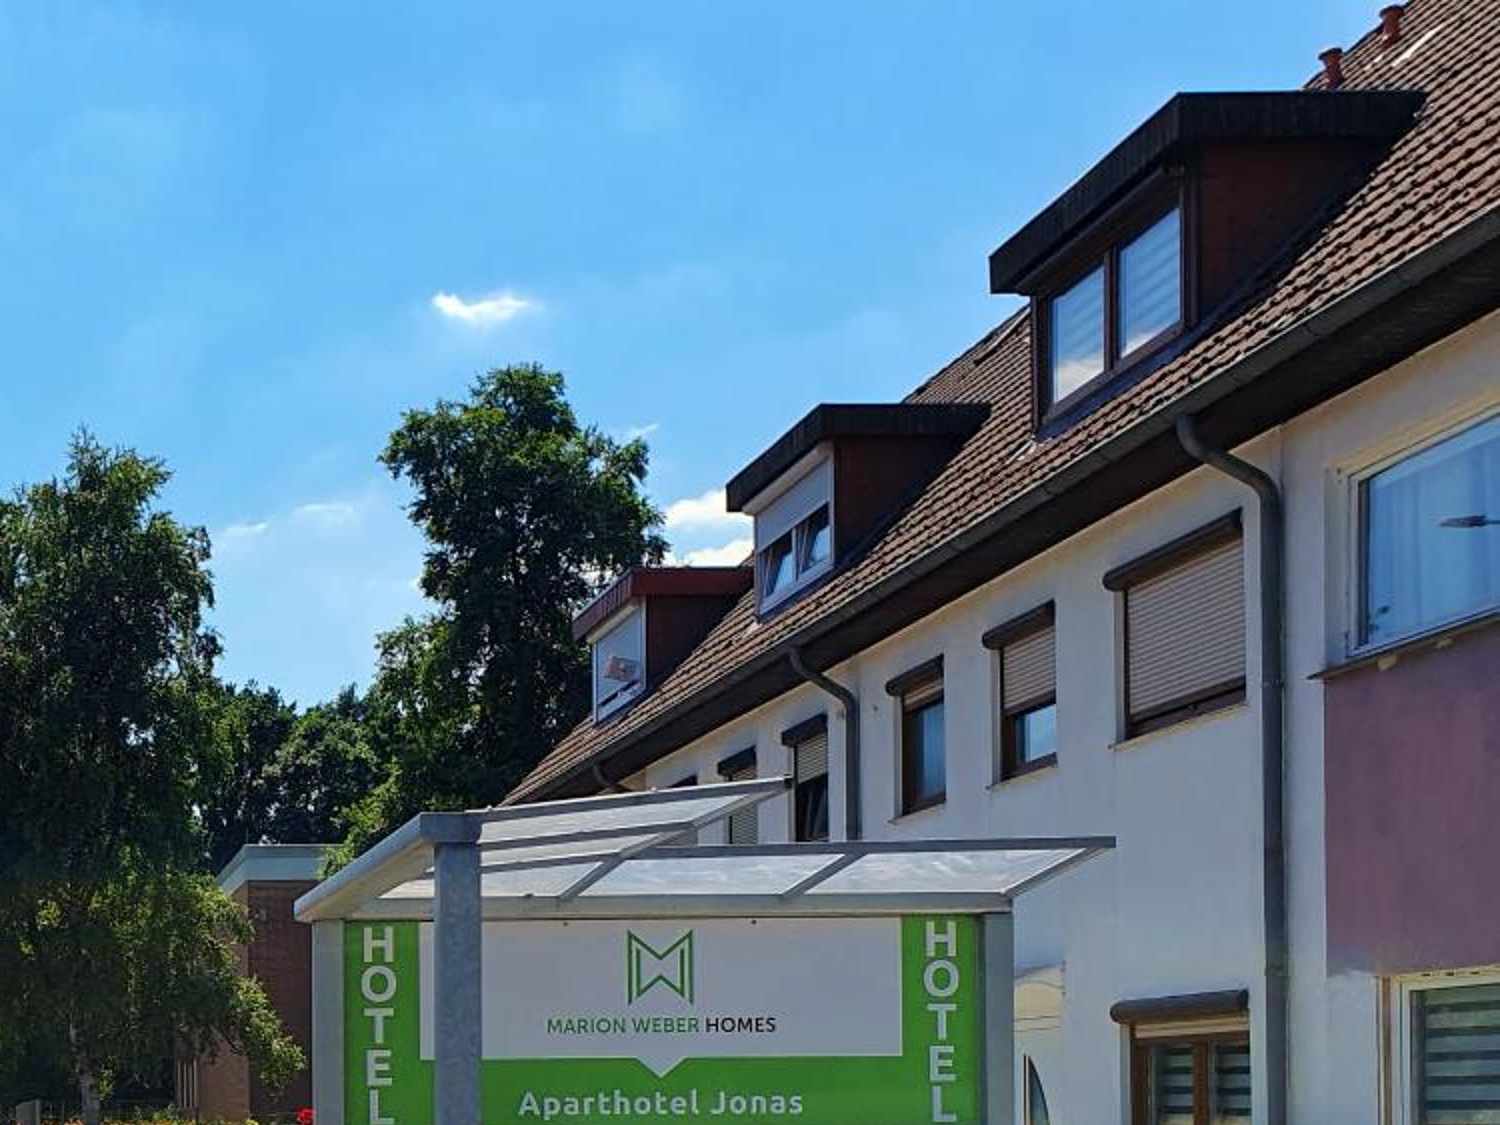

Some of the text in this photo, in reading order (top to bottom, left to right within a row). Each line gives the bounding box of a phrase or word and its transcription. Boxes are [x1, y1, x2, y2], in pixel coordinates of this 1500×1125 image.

[361, 926, 397, 1125] HOTEL
[547, 1016, 777, 1034] MARION WEBER HOMES
[923, 920, 960, 1123] HOTEL
[518, 1088, 804, 1121] Aparthotel Jonas
